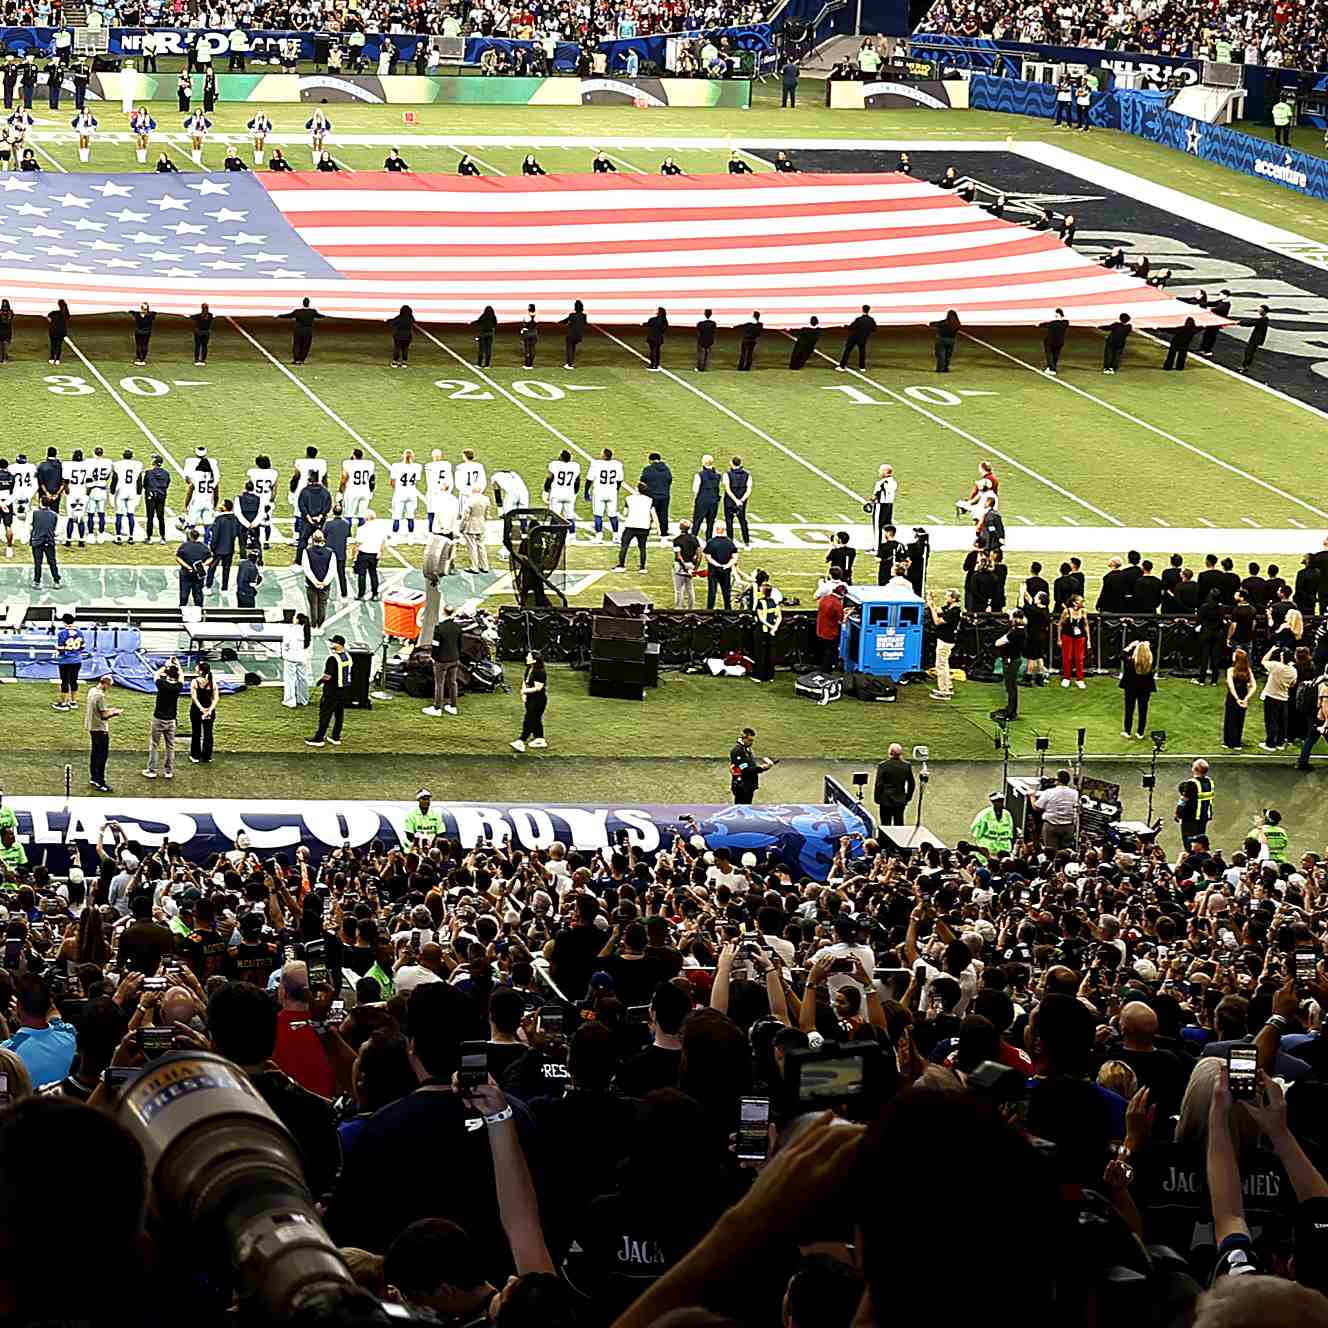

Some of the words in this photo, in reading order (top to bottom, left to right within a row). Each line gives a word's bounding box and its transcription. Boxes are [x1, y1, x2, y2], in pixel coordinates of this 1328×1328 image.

[1255, 158, 1307, 188] accenture
[43, 374, 170, 396] 30
[435, 378, 566, 401] 20
[821, 383, 963, 407] 10
[70, 469, 86, 485] 57
[91, 468, 107, 482] 45
[125, 469, 133, 484] 6
[353, 470, 371, 485] 90
[399, 473, 417, 487] 44
[438, 470, 445, 485] 5
[557, 470, 574, 487] 97
[599, 469, 617, 485] 92
[255, 479, 272, 494] 53
